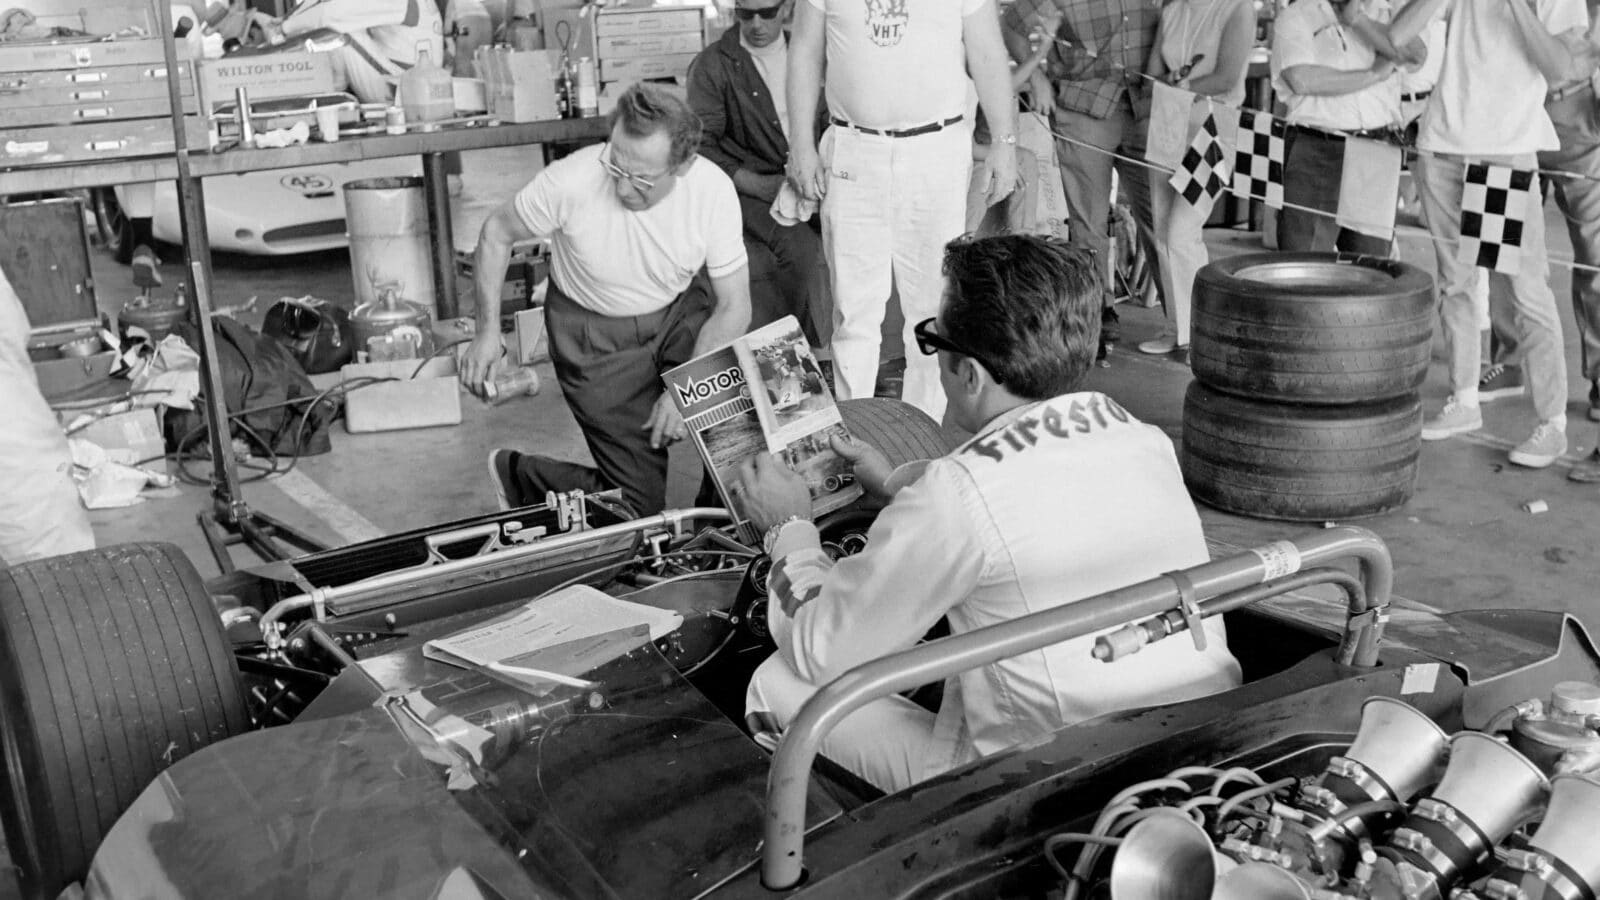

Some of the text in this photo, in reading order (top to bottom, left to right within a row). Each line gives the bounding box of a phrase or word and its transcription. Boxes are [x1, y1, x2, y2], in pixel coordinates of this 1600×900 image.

[872, 23, 901, 39] VHT
[216, 61, 314, 77] WILTON TOOL
[291, 175, 325, 189] 45
[674, 366, 746, 408] MOTOR
